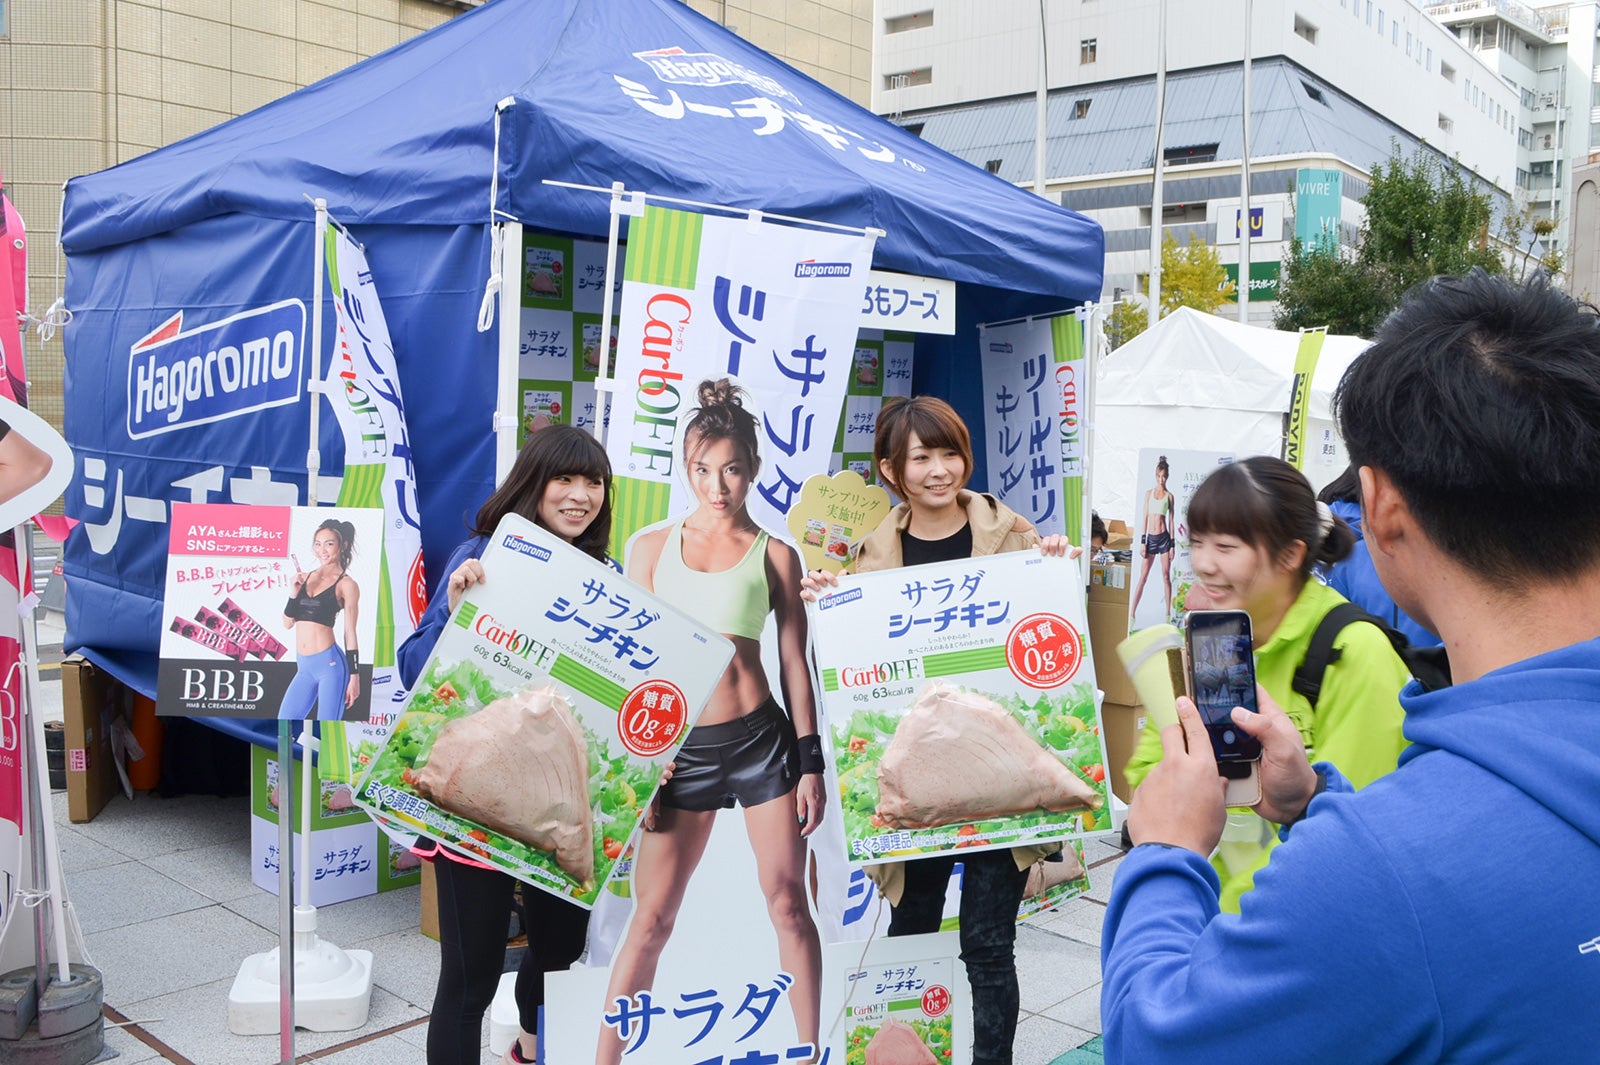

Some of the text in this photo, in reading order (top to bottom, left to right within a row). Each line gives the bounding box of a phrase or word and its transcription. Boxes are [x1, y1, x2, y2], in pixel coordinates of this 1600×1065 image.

[613, 75, 896, 163] シーチキン
[1298, 182, 1330, 196] VIVRE
[1237, 215, 1263, 230] U
[796, 263, 850, 279] Hagoromo
[578, 278, 623, 294] シーチン
[527, 329, 561, 344] サラダ
[519, 343, 568, 359] シーチキン
[886, 369, 911, 380] シーチキン
[890, 358, 909, 369] サラダ
[135, 329, 295, 424] Hagoromo
[631, 292, 693, 478] CarbOFF
[853, 412, 874, 425] サラダ
[818, 485, 881, 511] サンプリング
[826, 504, 866, 526] 実施中!
[187, 525, 283, 539] AYAさんと撮影をして
[504, 536, 551, 562] Hagoromo
[212, 574, 289, 596] プレゼント!!
[900, 569, 987, 608] サラダ
[582, 578, 661, 631] サラダ
[820, 589, 862, 611] Hagoromo
[888, 601, 1010, 639] シーチキン
[475, 613, 555, 667] CarbOFF
[544, 596, 660, 671] シーチキン
[1018, 620, 1057, 649] 糖質
[473, 644, 490, 660] 60g
[841, 658, 919, 688] CarbOFF
[179, 668, 265, 702] B.B.B
[641, 689, 676, 713] 糖質
[852, 692, 870, 702] 60g
[364, 780, 429, 819] まぐろ調理品
[852, 831, 913, 856] まぐろ調理品
[323, 845, 364, 865] サラダ
[314, 859, 371, 881] シーチキン
[882, 965, 919, 982] サラダ
[875, 978, 926, 995] シーチキン
[604, 973, 793, 1056] サラダ
